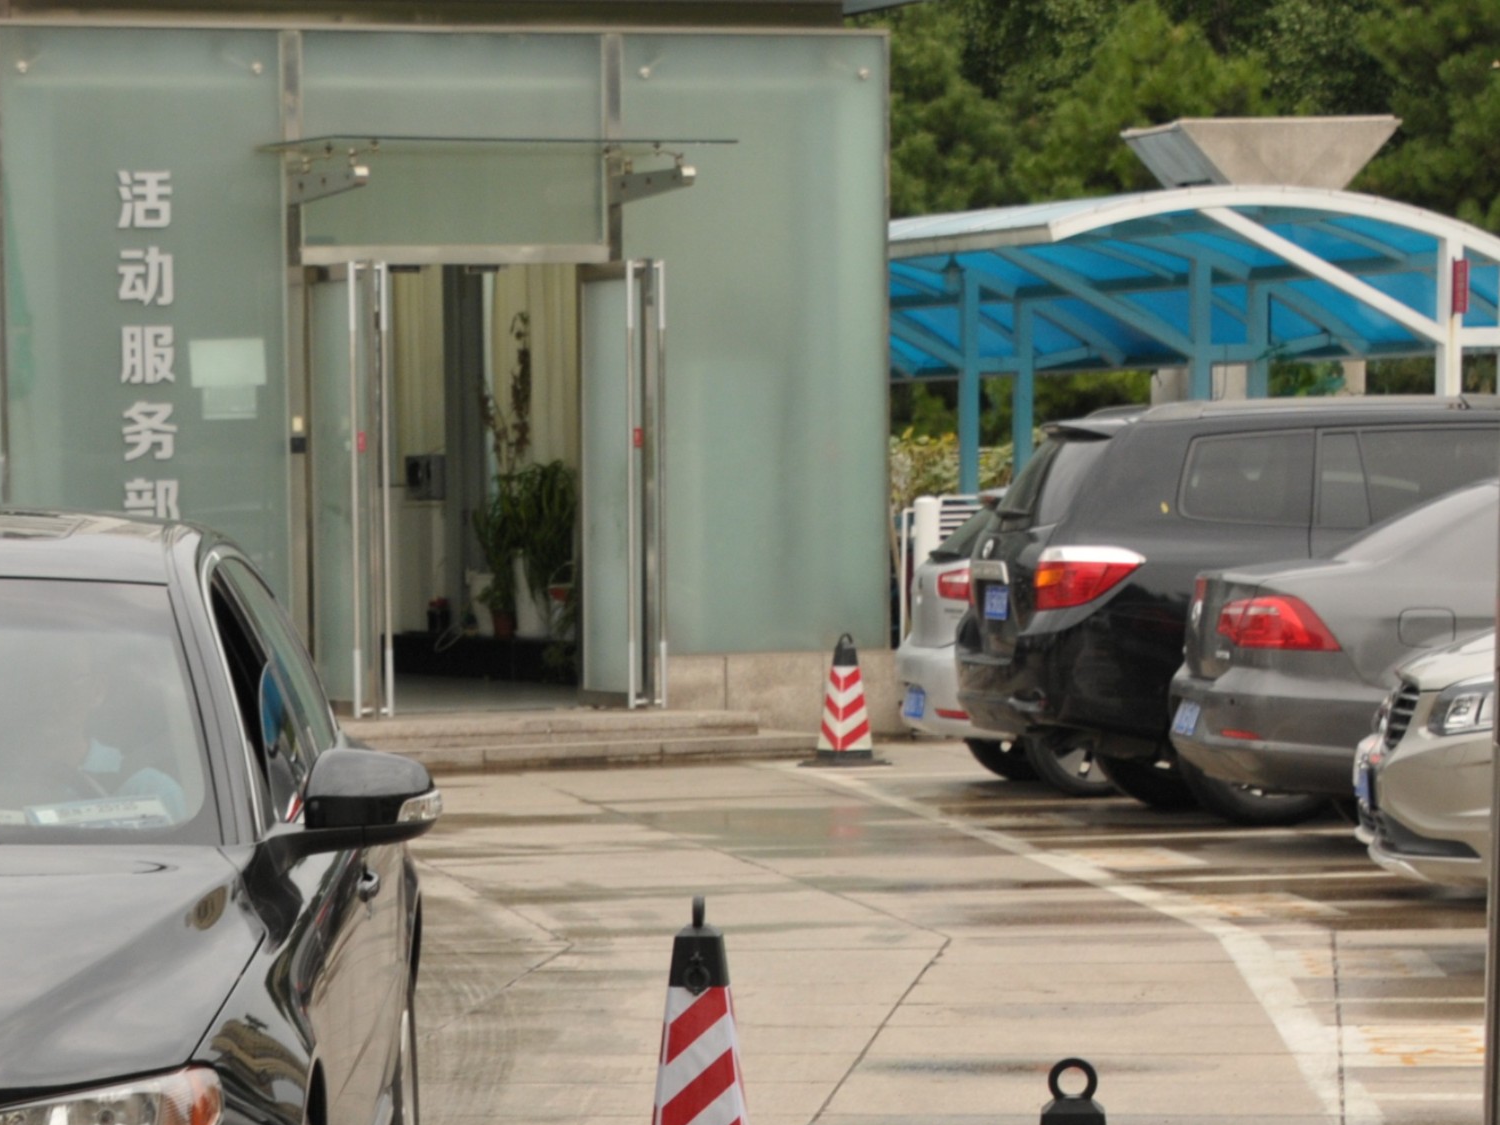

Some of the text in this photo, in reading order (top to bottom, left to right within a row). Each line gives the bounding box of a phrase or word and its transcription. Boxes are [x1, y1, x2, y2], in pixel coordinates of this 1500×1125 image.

[117, 170, 180, 520] 活动服务部
